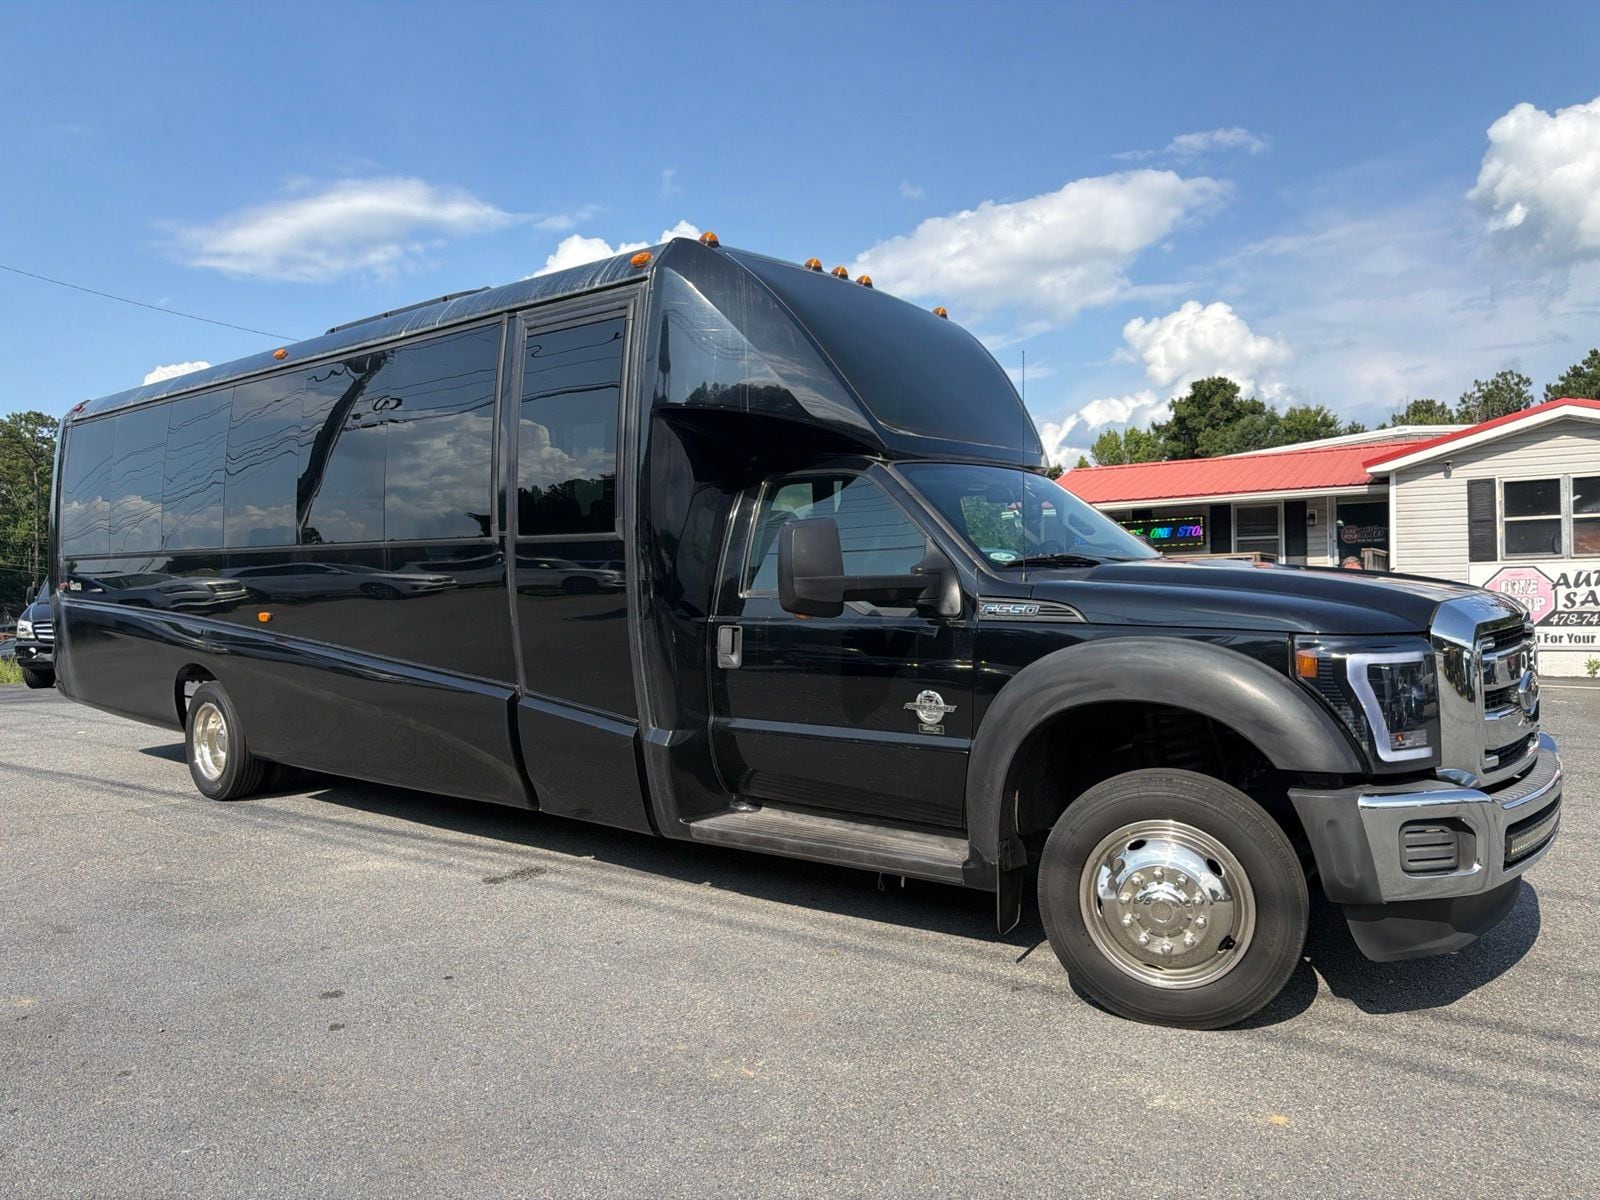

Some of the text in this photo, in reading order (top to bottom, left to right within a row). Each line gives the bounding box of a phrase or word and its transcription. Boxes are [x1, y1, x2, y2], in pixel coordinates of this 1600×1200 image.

[1177, 525, 1203, 537] STO
[1500, 579, 1538, 595] ONE
[1517, 596, 1547, 612] OP
[1549, 613, 1600, 625] 478-74
[1544, 633, 1564, 644] For
[1567, 633, 1596, 644] Your
